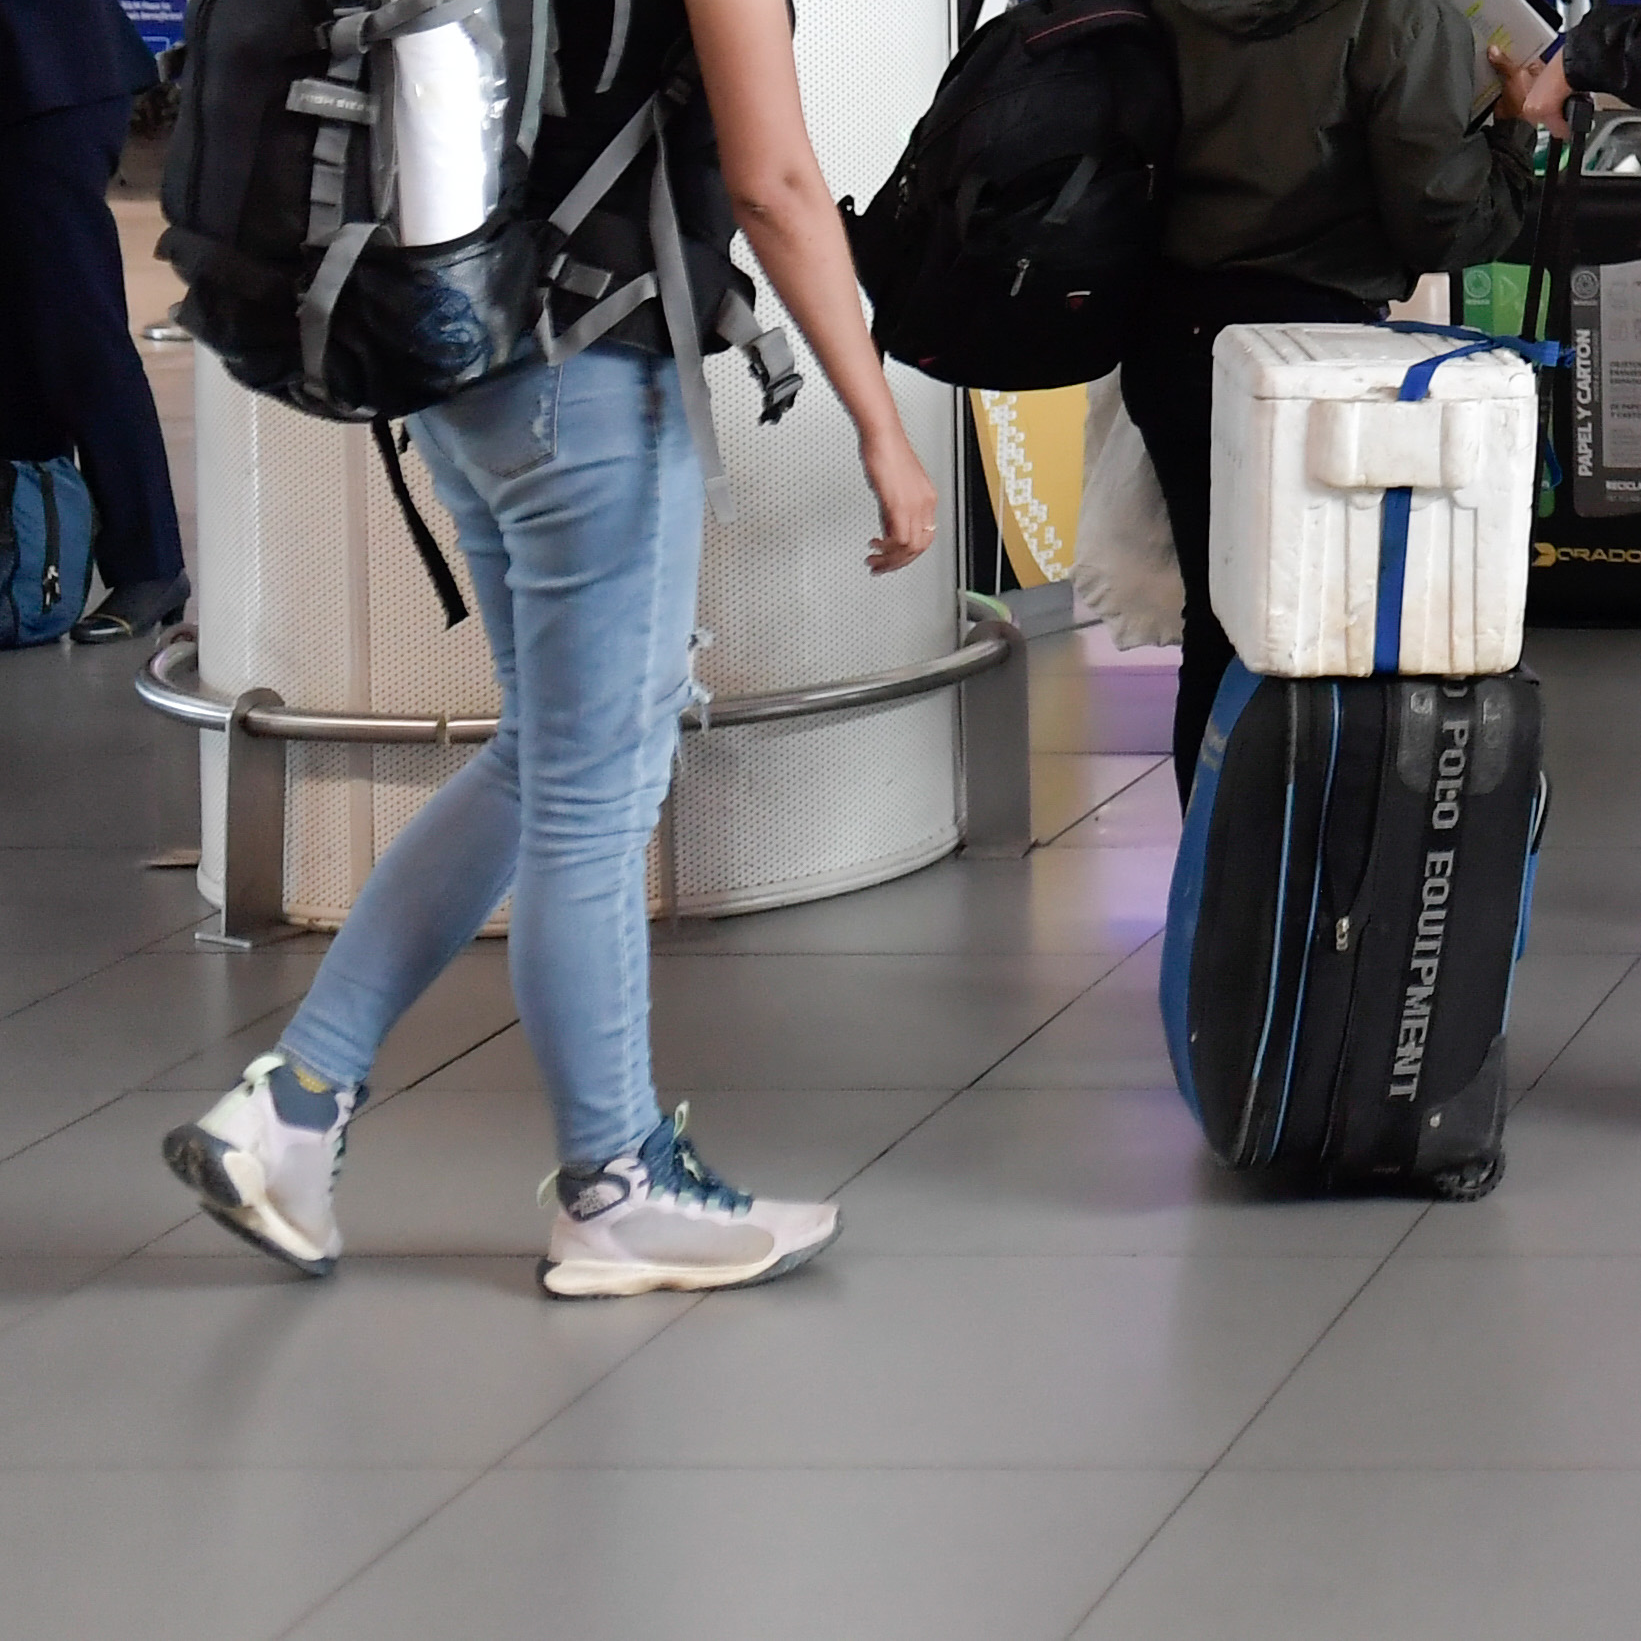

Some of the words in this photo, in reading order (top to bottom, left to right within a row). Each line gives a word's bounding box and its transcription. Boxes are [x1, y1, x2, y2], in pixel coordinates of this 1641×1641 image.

[1576, 408, 1592, 423] Y
[1576, 422, 1593, 477] PAPEL
[1432, 719, 1470, 829] POLO
[1389, 850, 1455, 1102] EQUIPMENT
